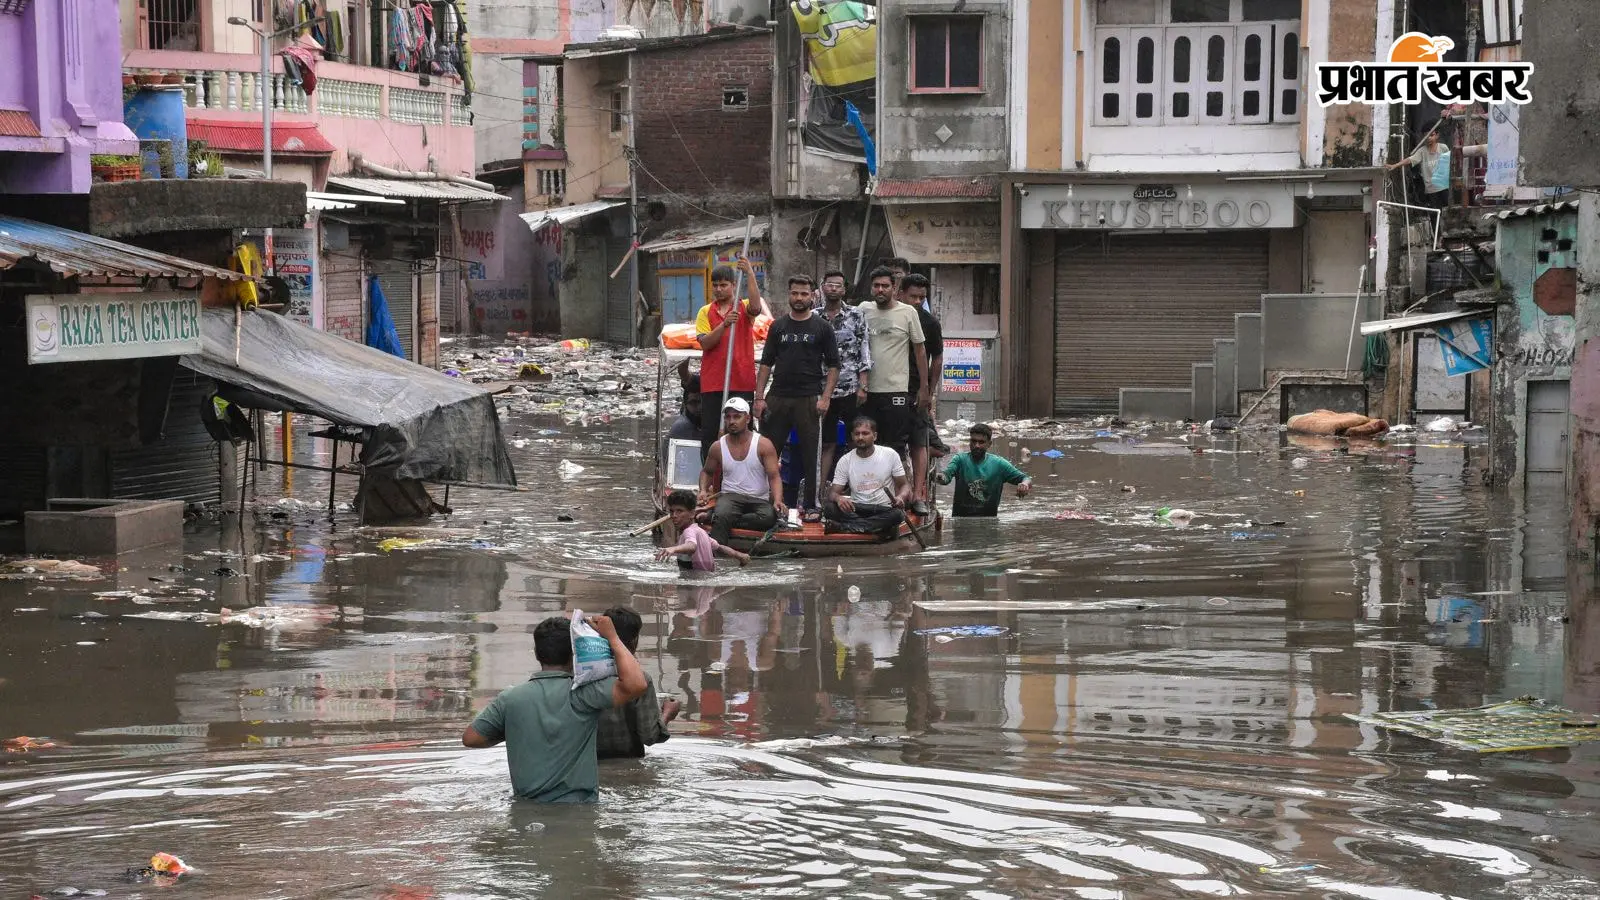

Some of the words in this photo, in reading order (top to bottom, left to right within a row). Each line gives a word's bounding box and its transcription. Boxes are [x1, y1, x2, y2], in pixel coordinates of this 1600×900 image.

[1041, 200, 1272, 228] KHUSHBOO
[60, 303, 104, 347] RAZA
[106, 302, 138, 344] TEA
[141, 299, 200, 342] CENTER
